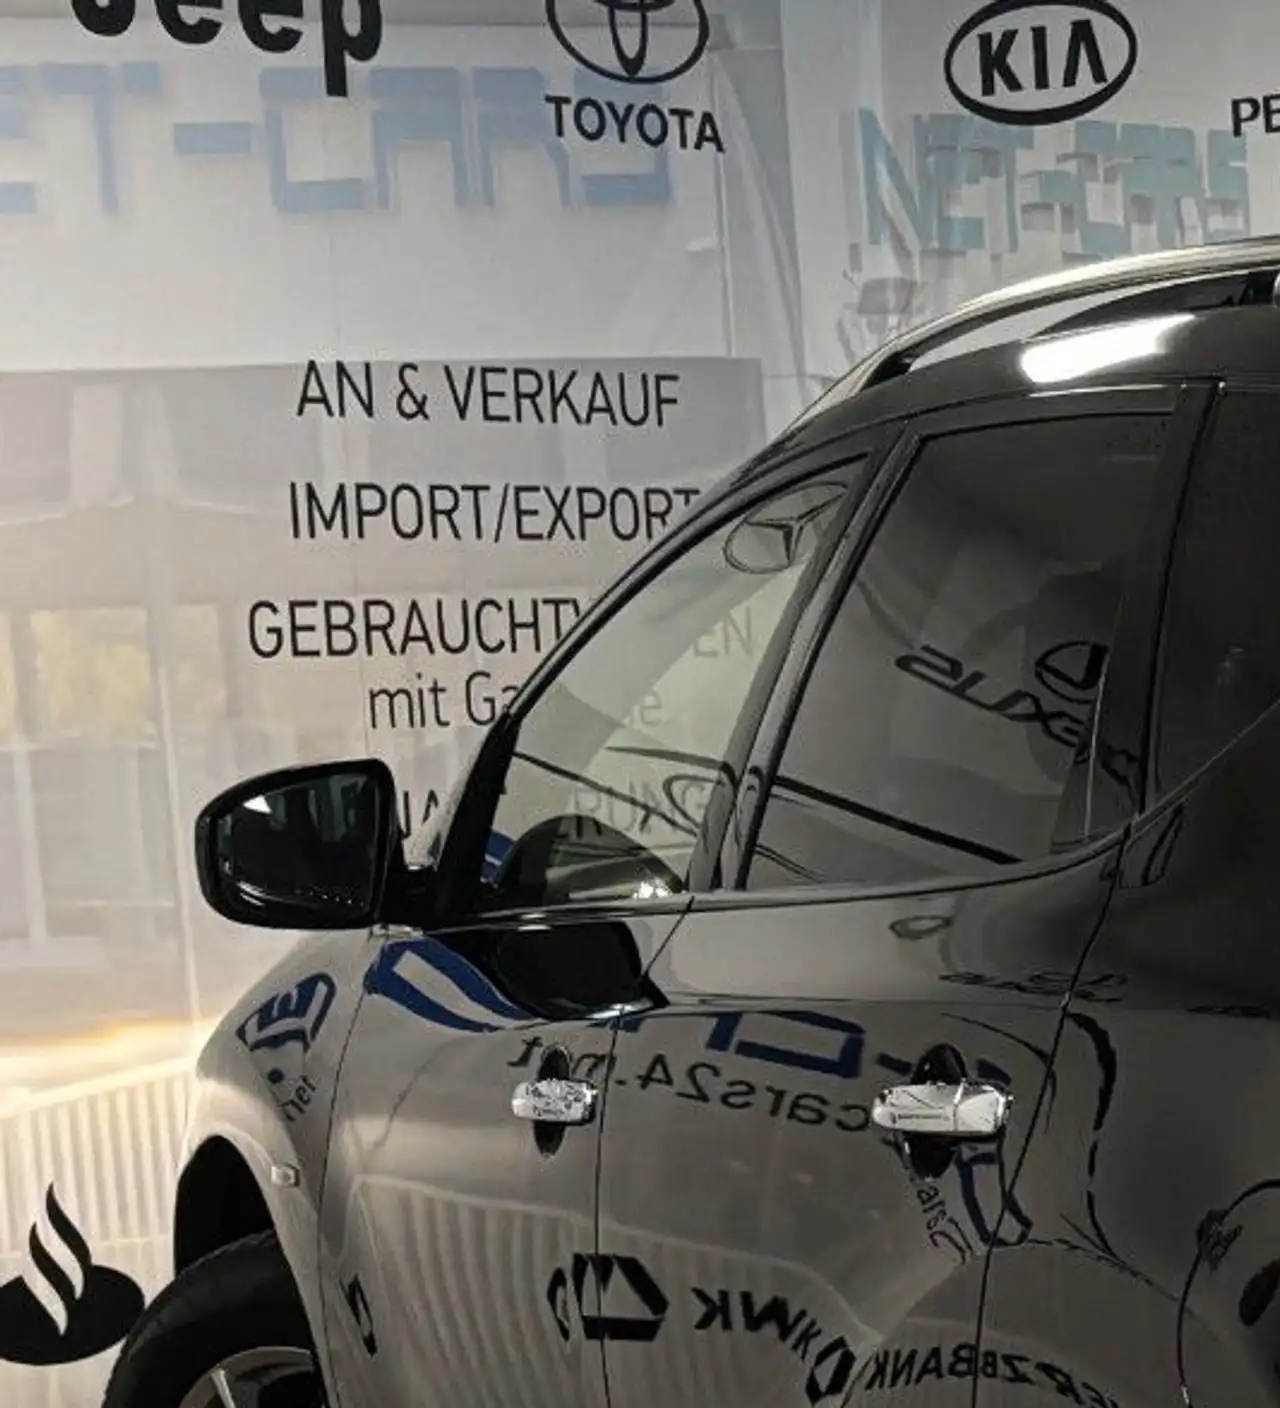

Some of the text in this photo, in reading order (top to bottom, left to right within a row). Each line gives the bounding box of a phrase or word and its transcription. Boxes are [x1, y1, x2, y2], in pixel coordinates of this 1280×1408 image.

[976, 19, 1108, 97] KIA
[544, 94, 726, 153] TOYOTA
[296, 358, 681, 428] AN & VERKAUF
[368, 672, 450, 729] mit
